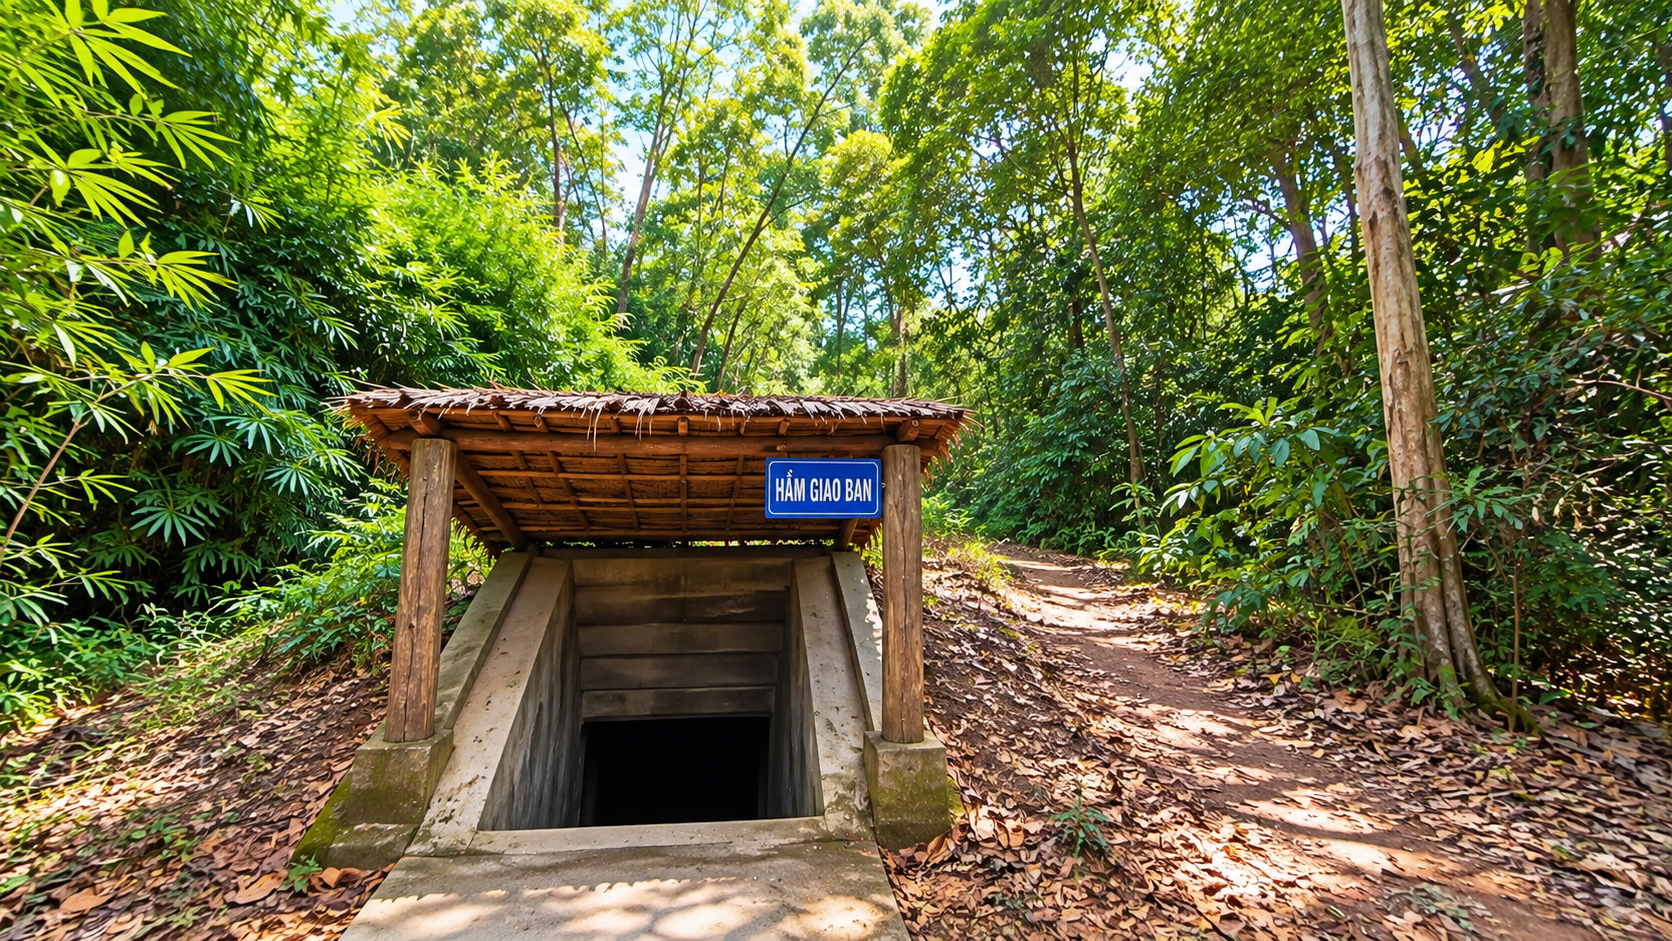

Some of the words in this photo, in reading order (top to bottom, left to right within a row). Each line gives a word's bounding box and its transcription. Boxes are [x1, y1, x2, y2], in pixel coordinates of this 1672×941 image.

[775, 469, 805, 501] HẦM
[810, 478, 841, 502] GIAO
[845, 478, 872, 502] BAN
